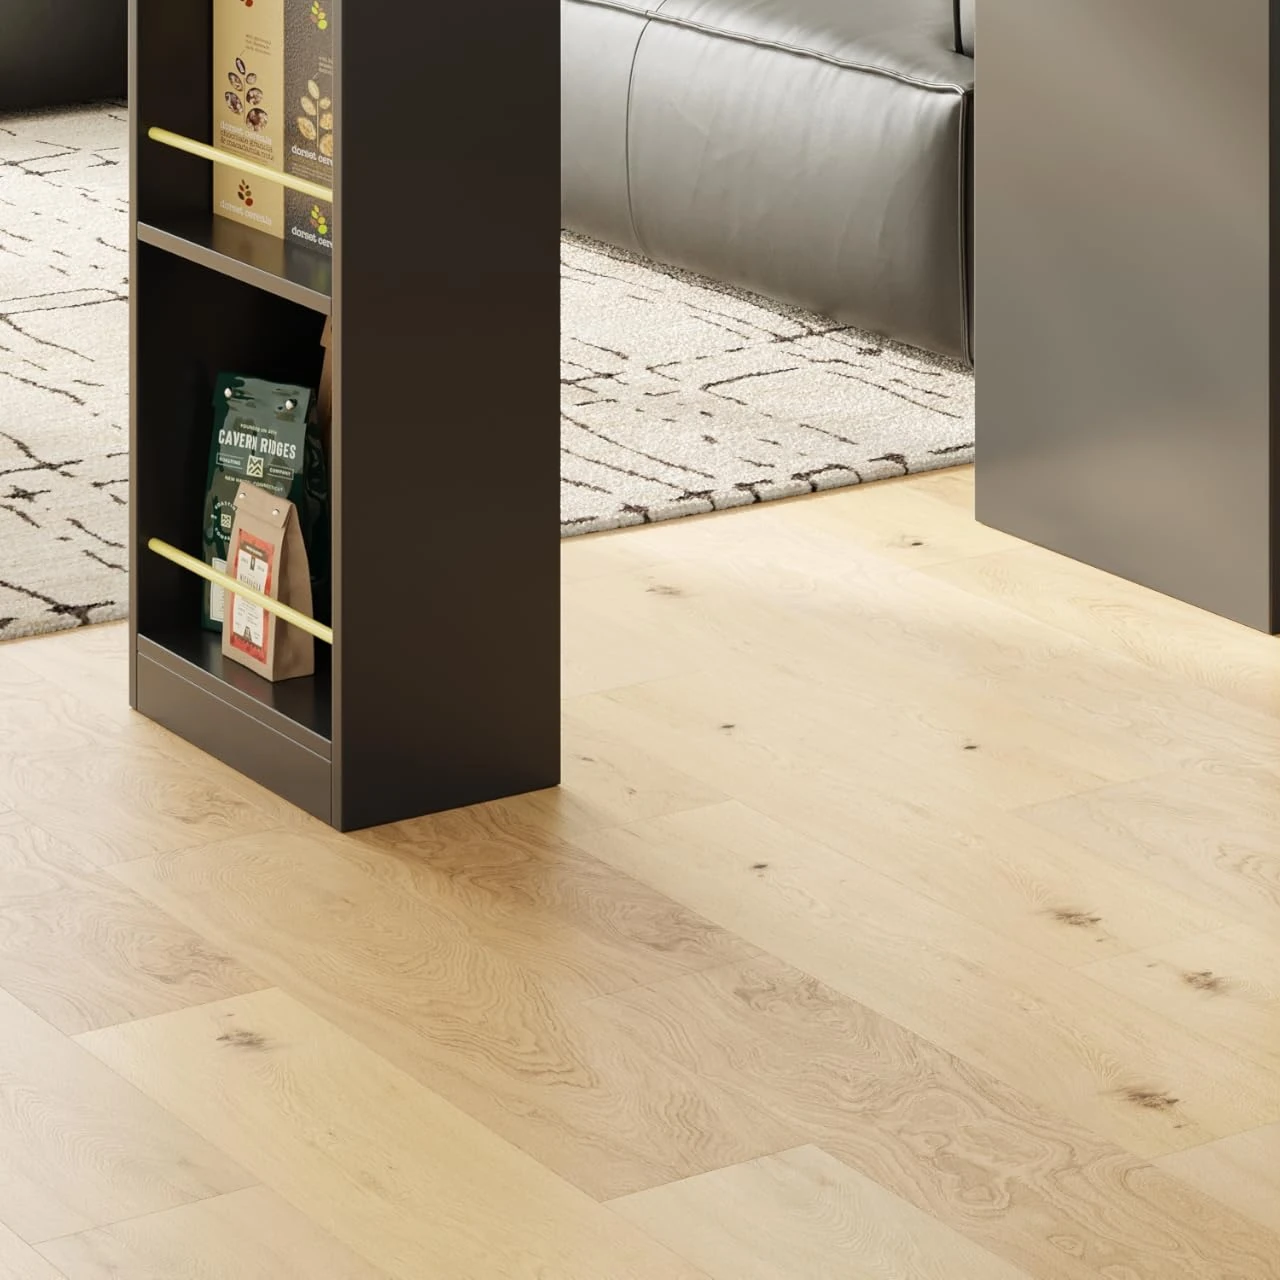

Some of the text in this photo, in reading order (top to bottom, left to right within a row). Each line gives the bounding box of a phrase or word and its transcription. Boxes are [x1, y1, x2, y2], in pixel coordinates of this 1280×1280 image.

[291, 145, 317, 161] dorset
[291, 226, 317, 243] dorset
[218, 429, 297, 460] CAVERN RIDGES
